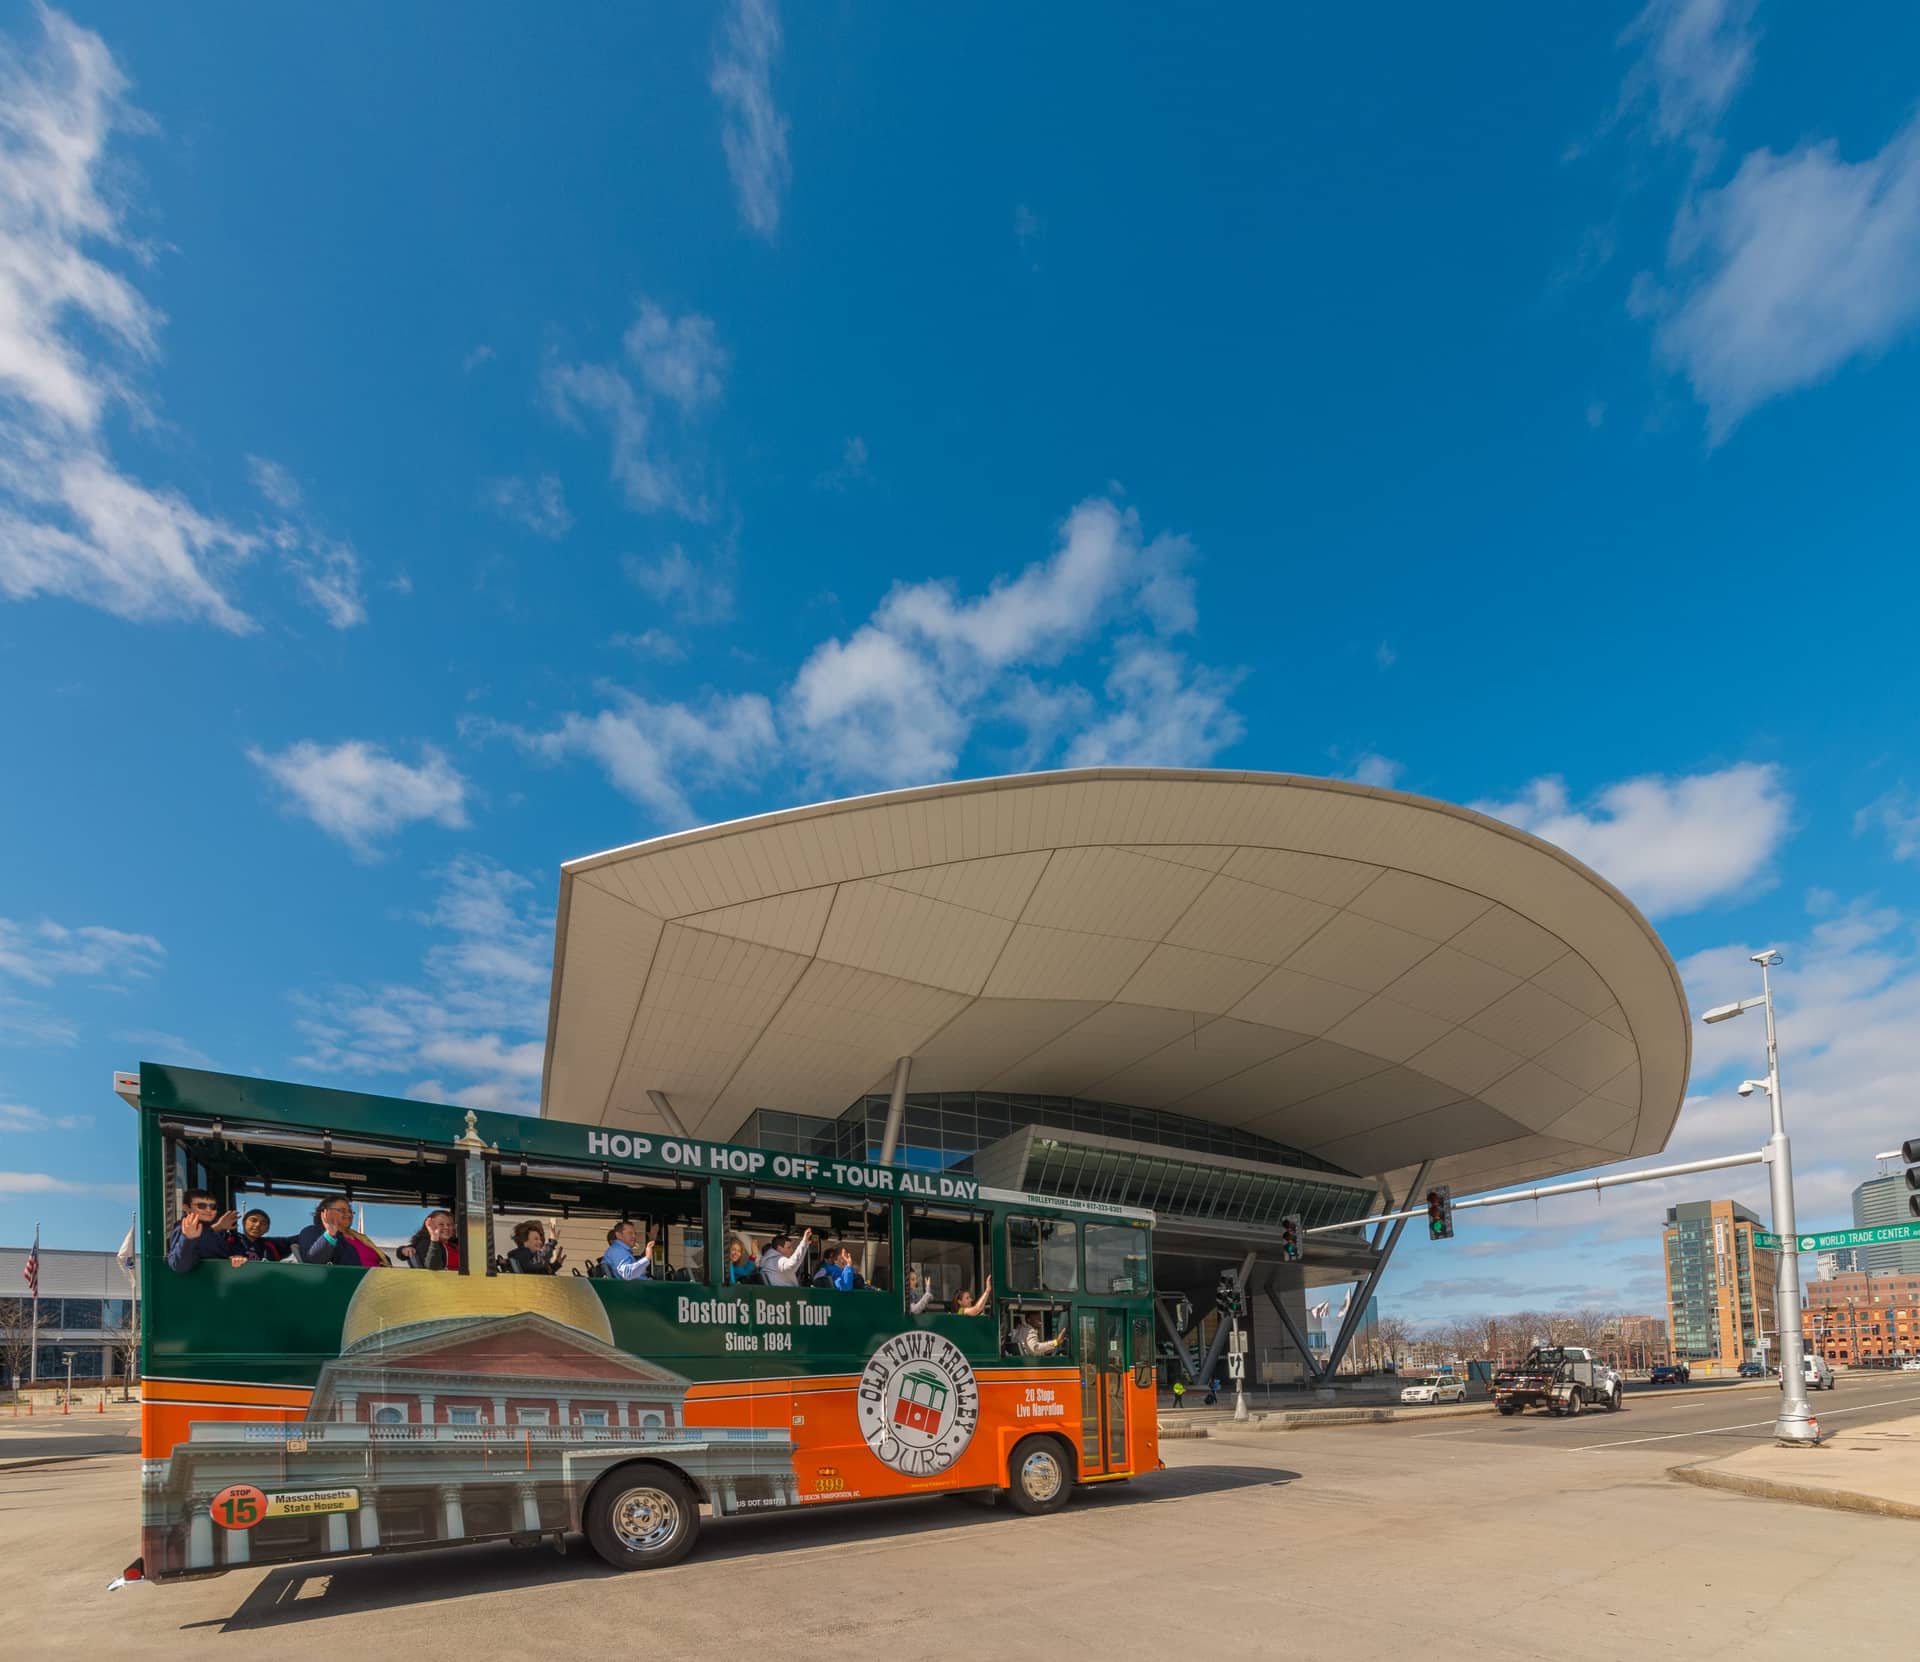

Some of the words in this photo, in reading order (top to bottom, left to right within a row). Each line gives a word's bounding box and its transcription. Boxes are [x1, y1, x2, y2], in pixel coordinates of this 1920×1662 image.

[588, 1131, 652, 1159] HOP
[661, 1142, 701, 1167] ON
[710, 1147, 765, 1173] HOP
[772, 1156, 819, 1180] OFF
[899, 1173, 937, 1195] ALL
[940, 1178, 977, 1199] DAY
[1819, 1233, 1846, 1247] WORLD
[1849, 1230, 1874, 1243] TRADE
[1877, 1226, 1910, 1240] CENTER
[678, 1296, 749, 1325] Boston's
[756, 1299, 791, 1325] Best
[797, 1300, 832, 1326] Tour
[725, 1331, 758, 1351] Since
[762, 1332, 792, 1351] 1984
[860, 1360, 890, 1402] OLD
[882, 1333, 936, 1367] TOWN
[938, 1342, 977, 1435] TROLLEY
[1025, 1388, 1035, 1402] 20
[1036, 1388, 1055, 1403] Stops
[1016, 1403, 1031, 1417] Live
[1032, 1403, 1064, 1416] Narration
[867, 1417, 952, 1475] TOURS
[230, 1489, 251, 1497] STOP
[275, 1490, 350, 1504] Massachusetts
[220, 1497, 257, 1524] 15
[283, 1503, 311, 1513] State
[314, 1502, 344, 1511] House
[736, 1500, 746, 1508] US
[747, 1499, 760, 1507] DOT
